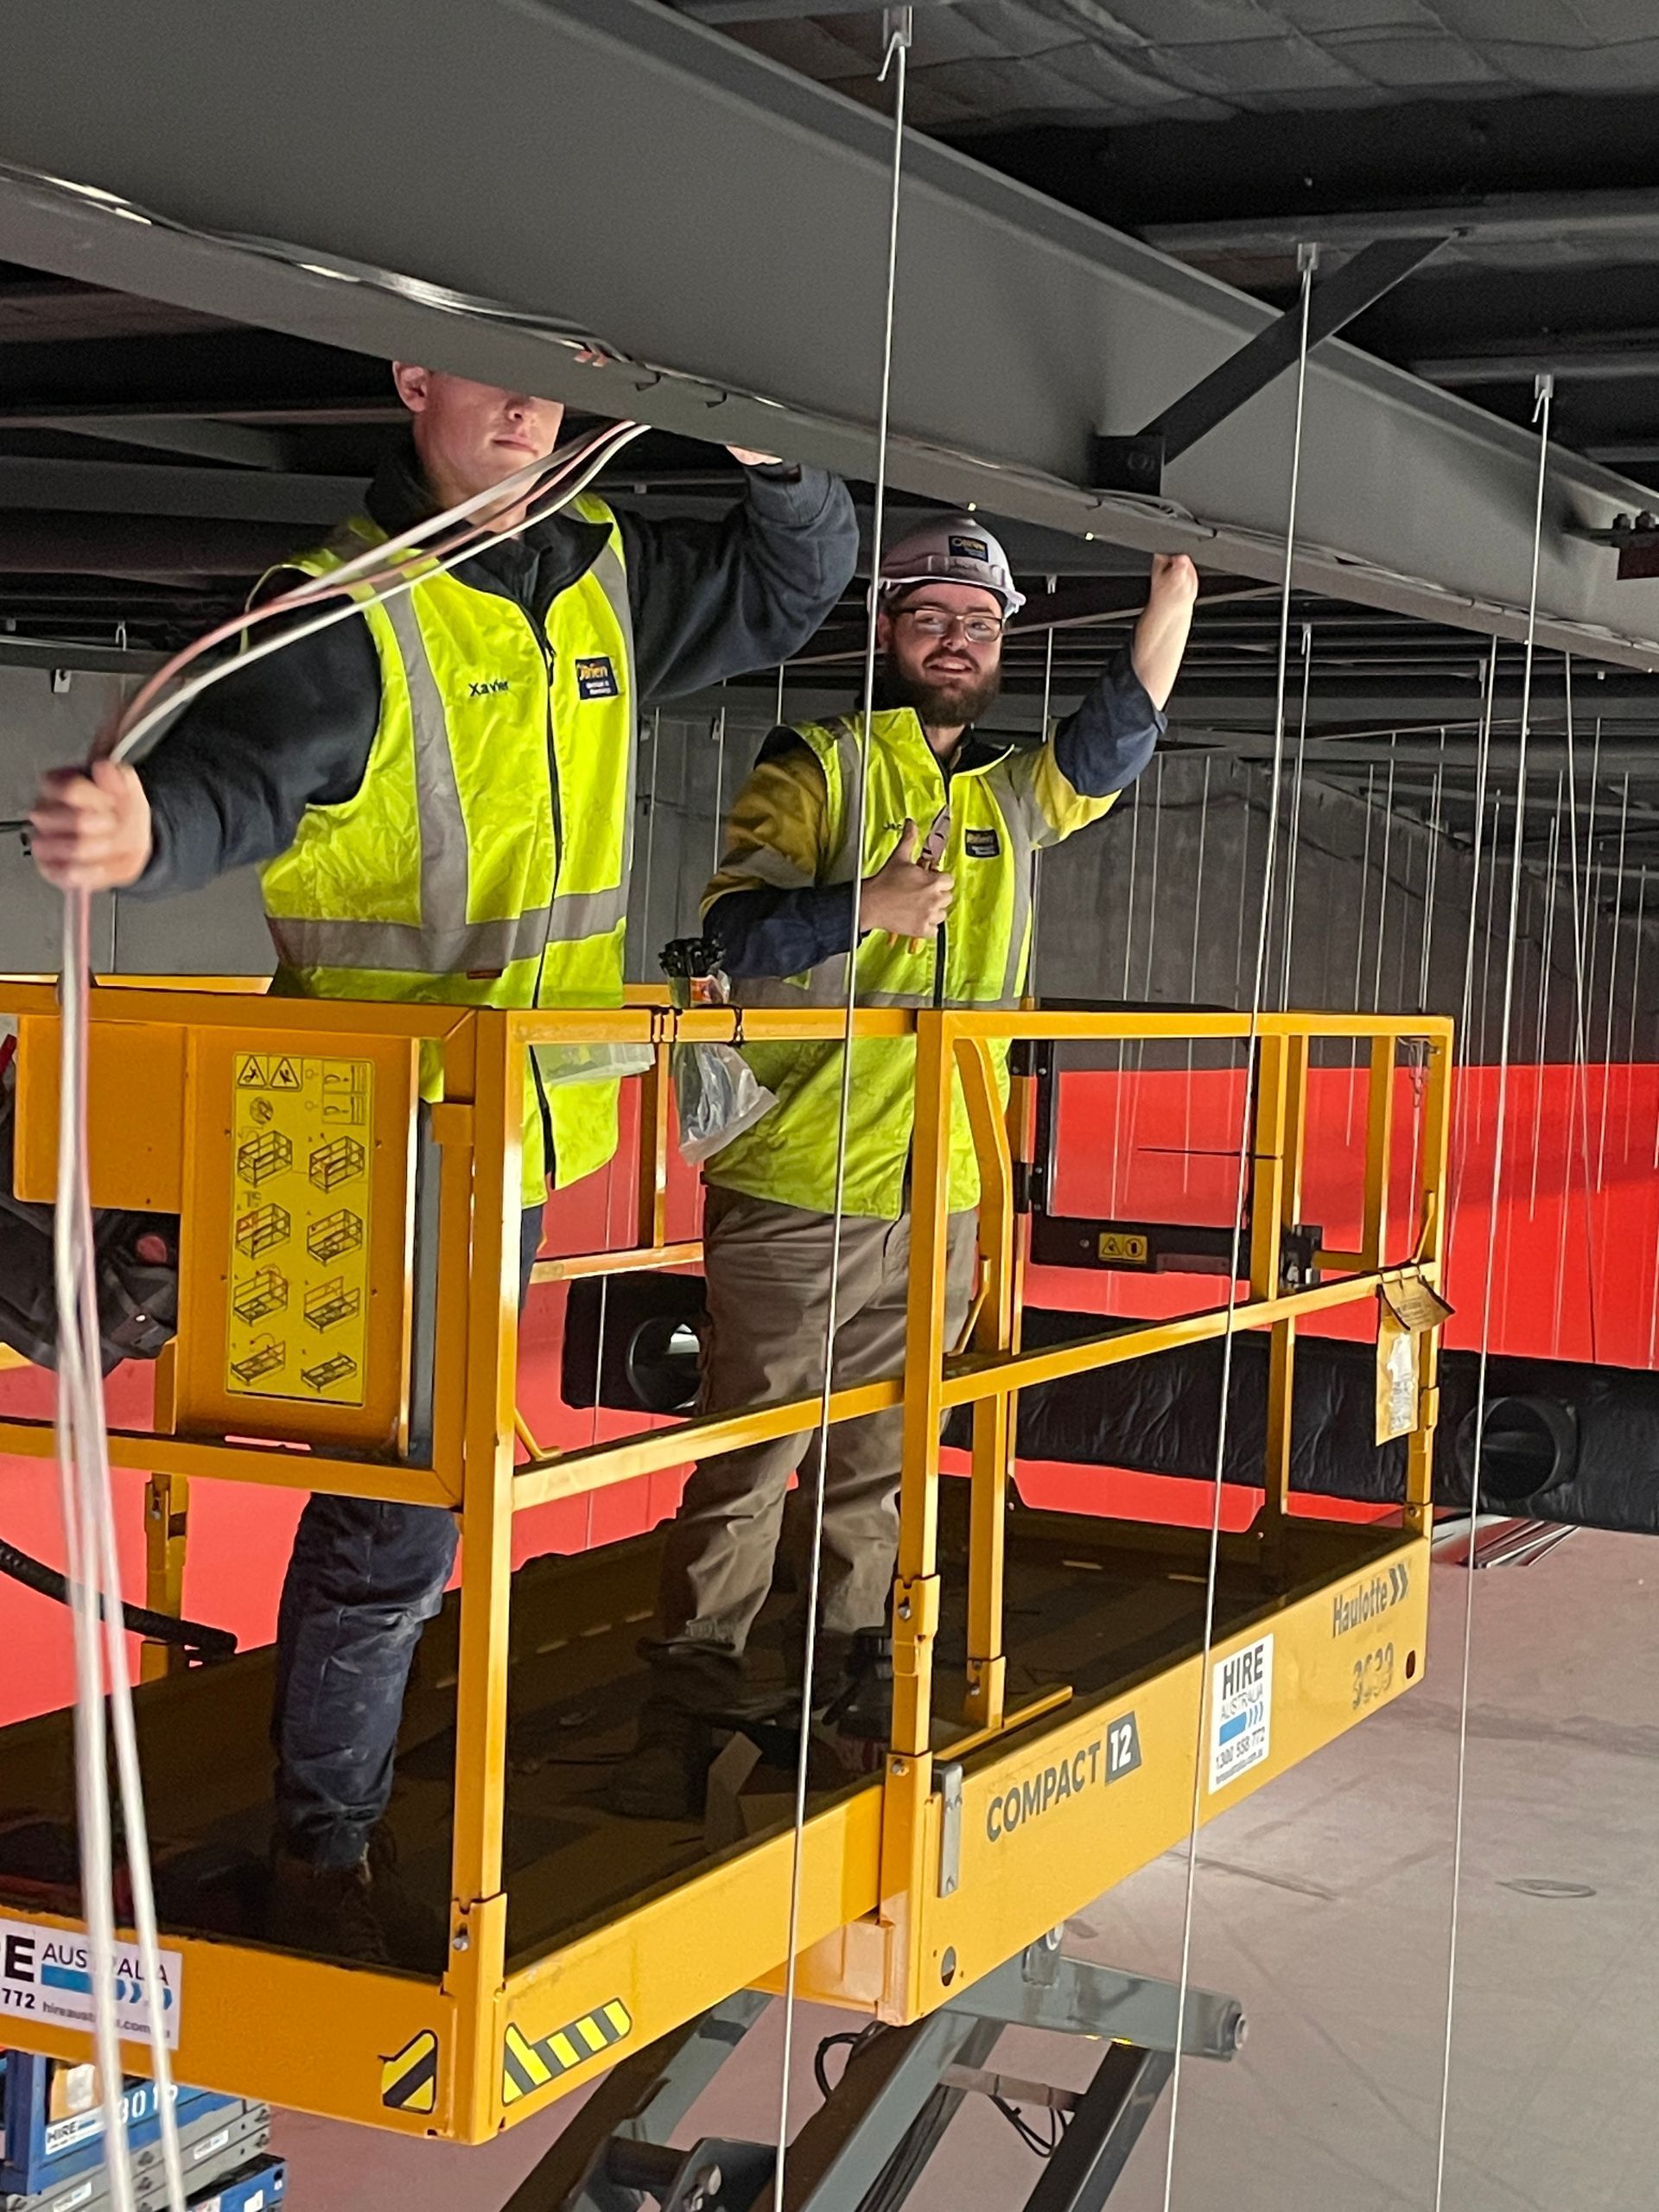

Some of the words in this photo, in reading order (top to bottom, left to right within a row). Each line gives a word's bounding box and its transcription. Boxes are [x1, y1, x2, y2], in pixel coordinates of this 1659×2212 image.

[468, 679, 509, 697] Xavier
[1333, 1577, 1388, 1639] Haulotte
[1223, 1643, 1264, 1701] HIRE
[986, 1740, 1101, 1842] COMPACT
[1110, 1724, 1132, 1772] 12
[1, 1988, 35, 2010] 772
